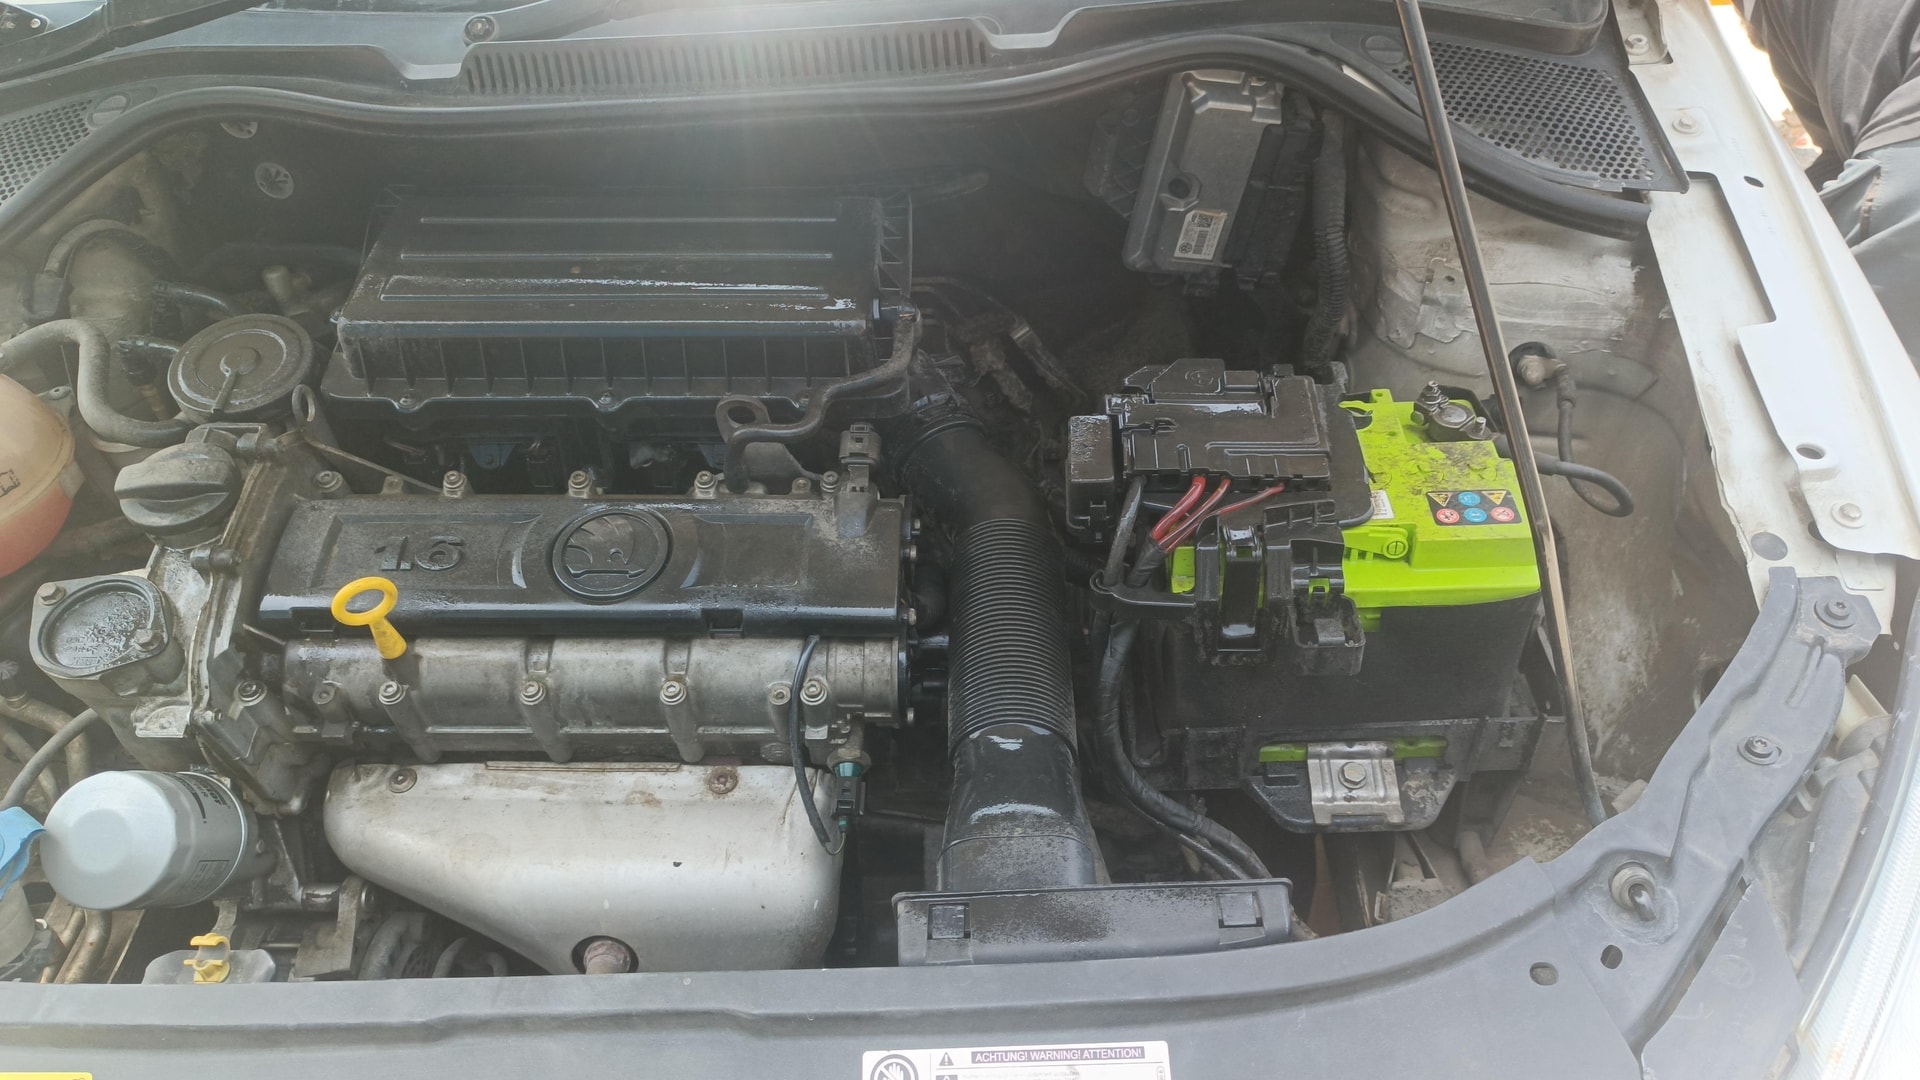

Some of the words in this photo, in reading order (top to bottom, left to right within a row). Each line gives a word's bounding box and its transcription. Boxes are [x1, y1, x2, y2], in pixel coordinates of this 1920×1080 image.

[375, 534, 464, 571] 1.6
[975, 1051, 1028, 1063] ACHTUNG!
[1030, 1049, 1080, 1061] WARNING!
[1082, 1047, 1142, 1060] ATTENTION!
